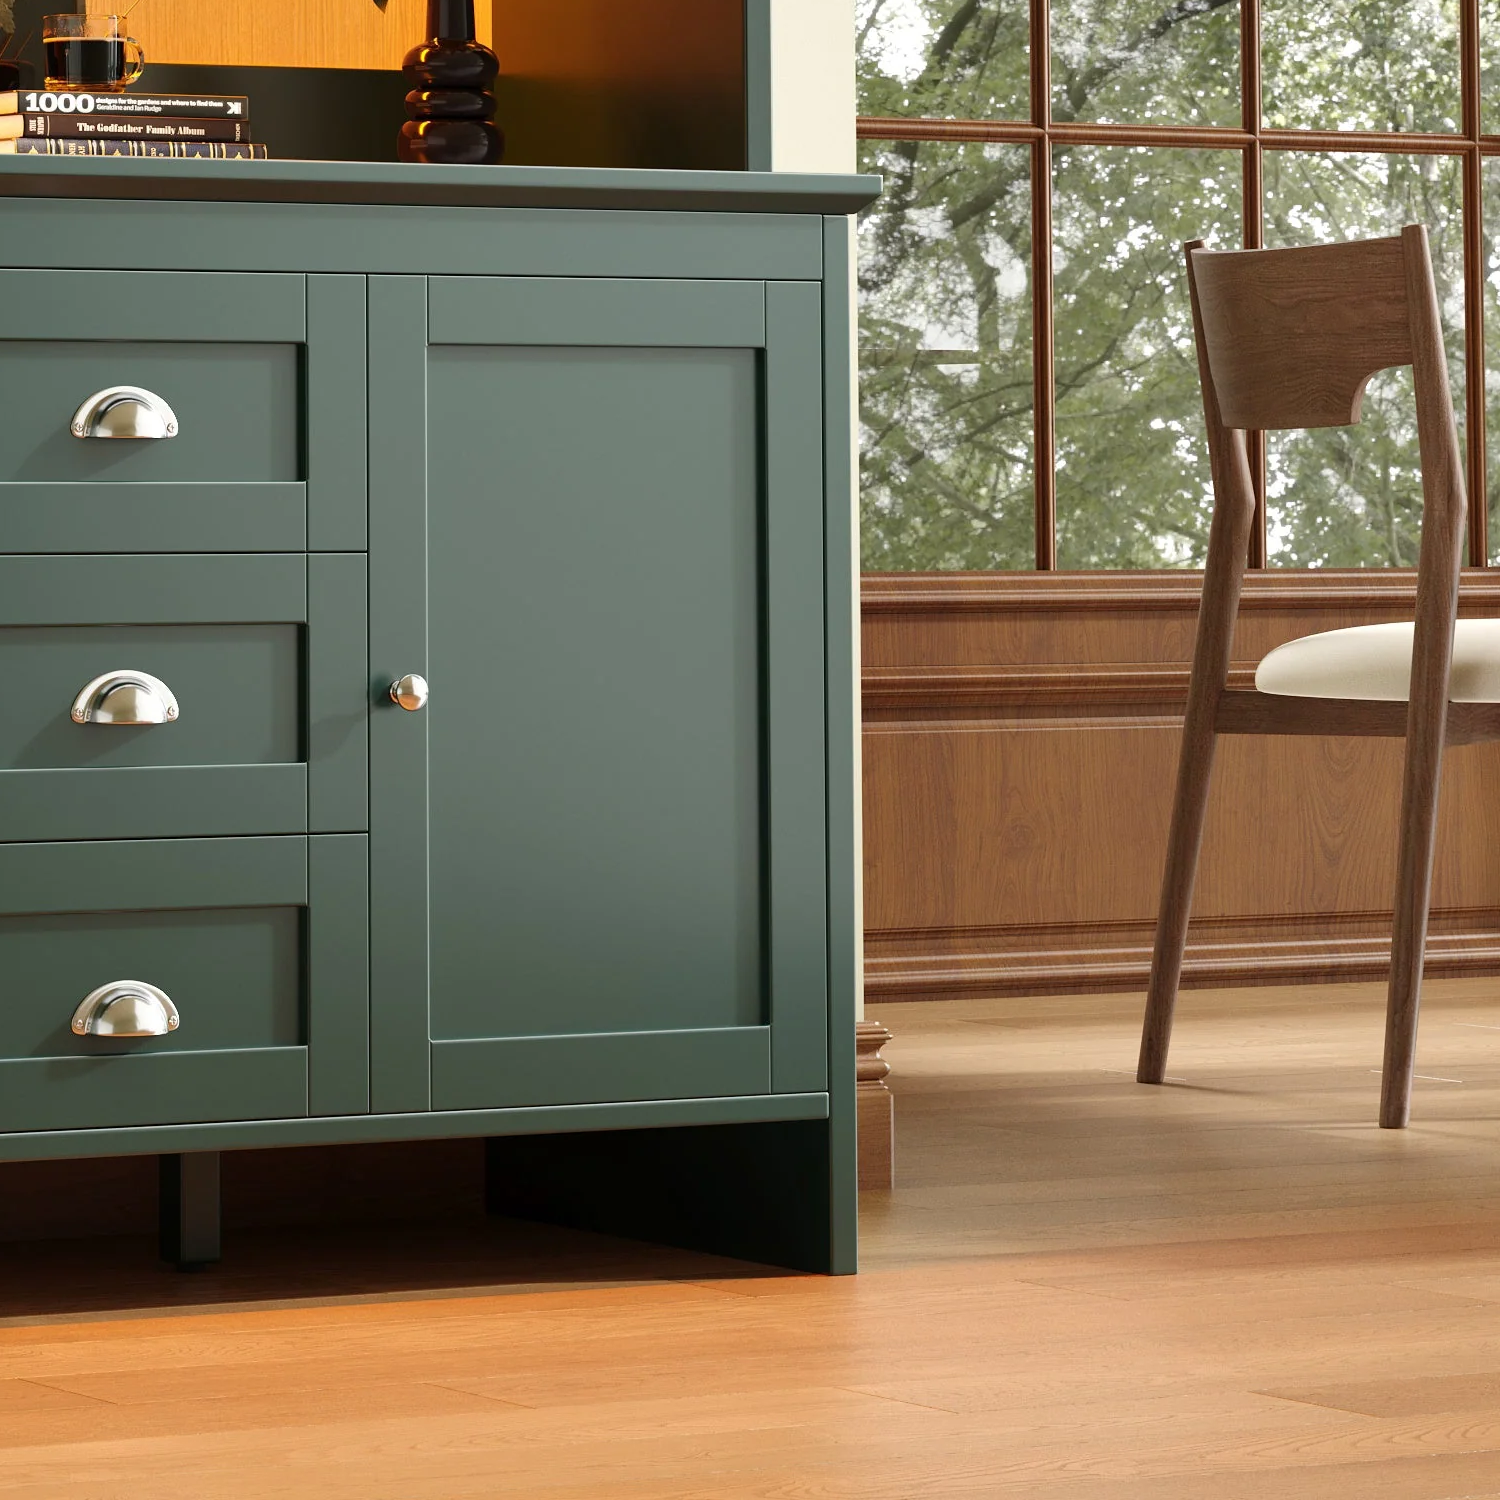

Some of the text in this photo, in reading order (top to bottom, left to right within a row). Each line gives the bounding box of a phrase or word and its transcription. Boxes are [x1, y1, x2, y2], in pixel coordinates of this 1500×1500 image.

[26, 92, 95, 113] 1000
[118, 97, 127, 105] for
[97, 103, 123, 111] Geraldine
[77, 122, 206, 136] The Godfather Family Album
